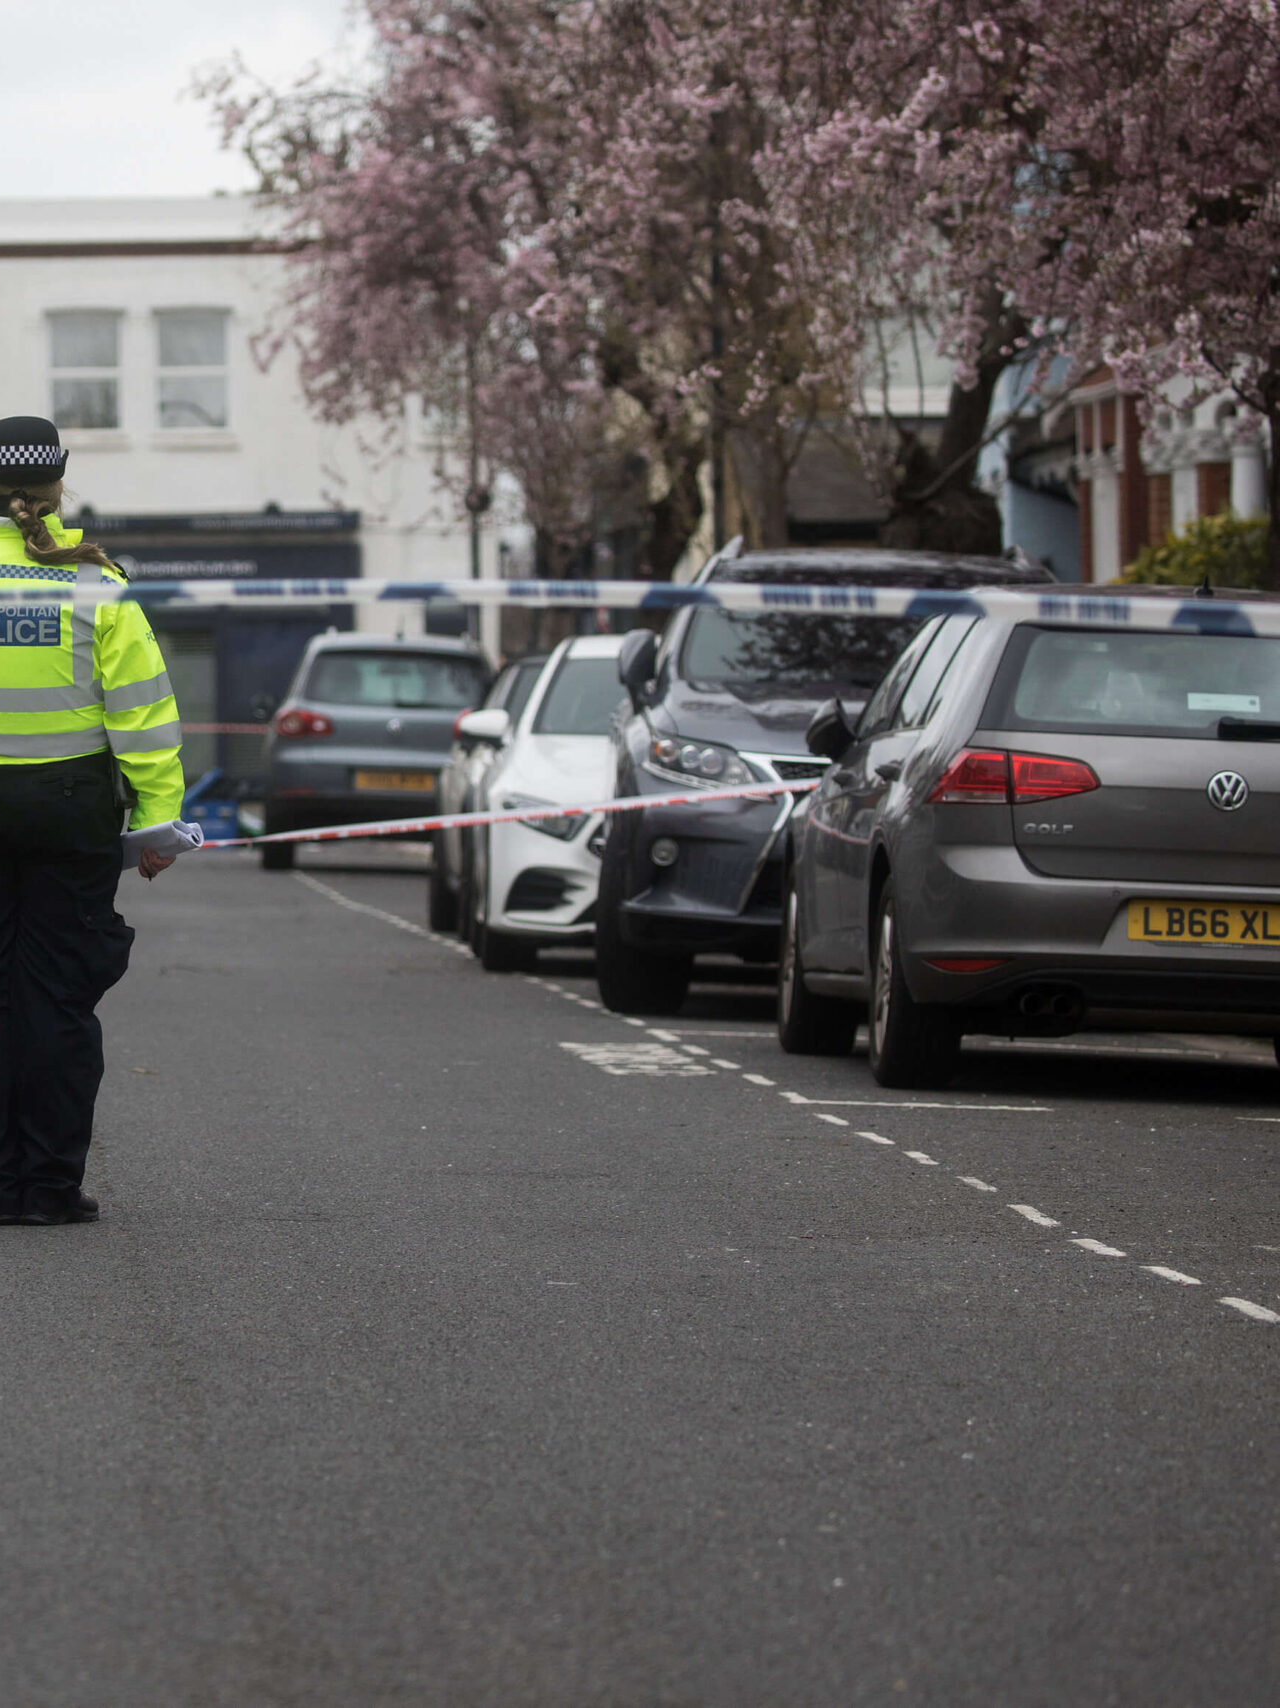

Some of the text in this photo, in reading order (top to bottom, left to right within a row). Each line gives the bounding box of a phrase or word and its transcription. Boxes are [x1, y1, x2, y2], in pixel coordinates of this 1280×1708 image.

[1023, 822, 1074, 835] GOLF
[1143, 906, 1280, 940] LB66 XL
